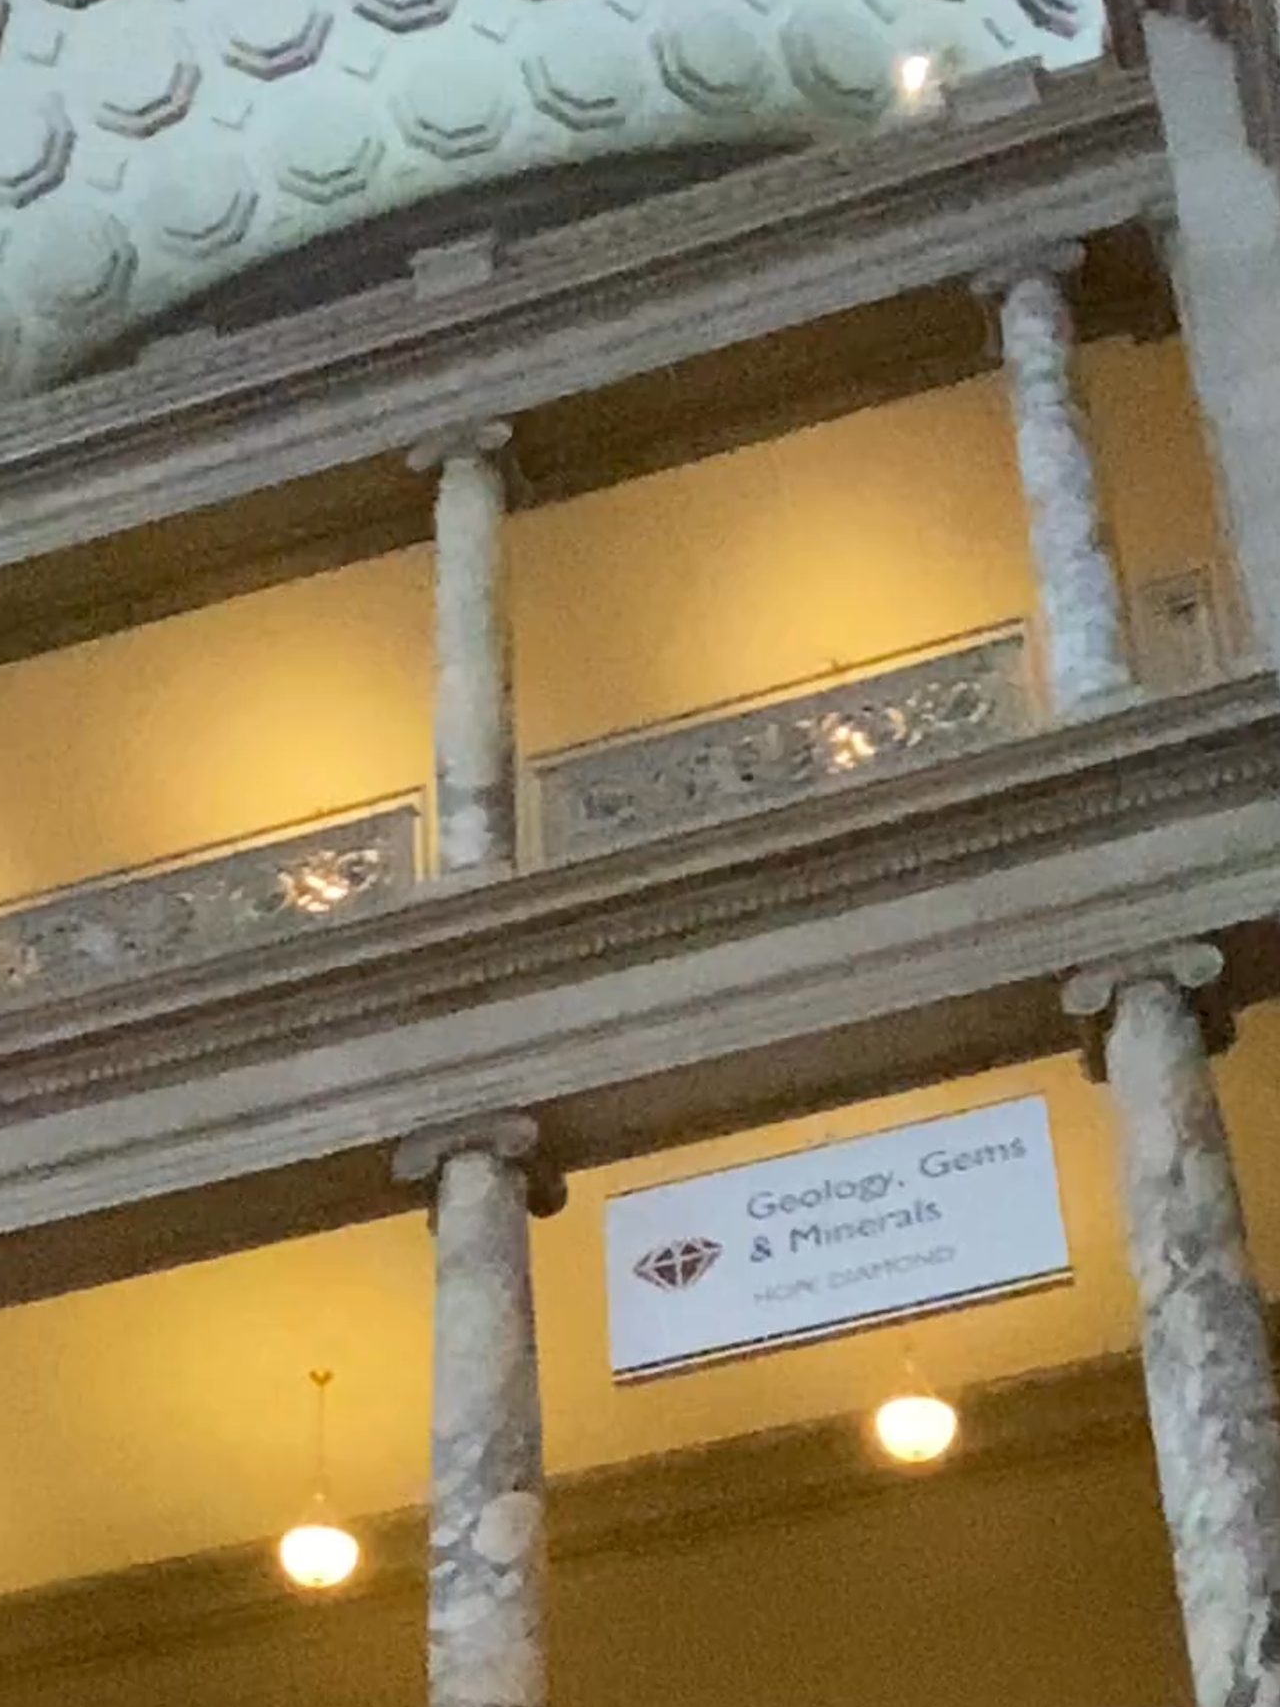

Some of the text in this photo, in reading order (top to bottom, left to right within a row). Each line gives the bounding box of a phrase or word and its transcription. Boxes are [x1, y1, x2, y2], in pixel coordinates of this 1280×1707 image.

[919, 1135, 1027, 1180] Gems
[749, 1200, 943, 1263] & Minerals
[827, 1245, 956, 1291] DIAMOND
